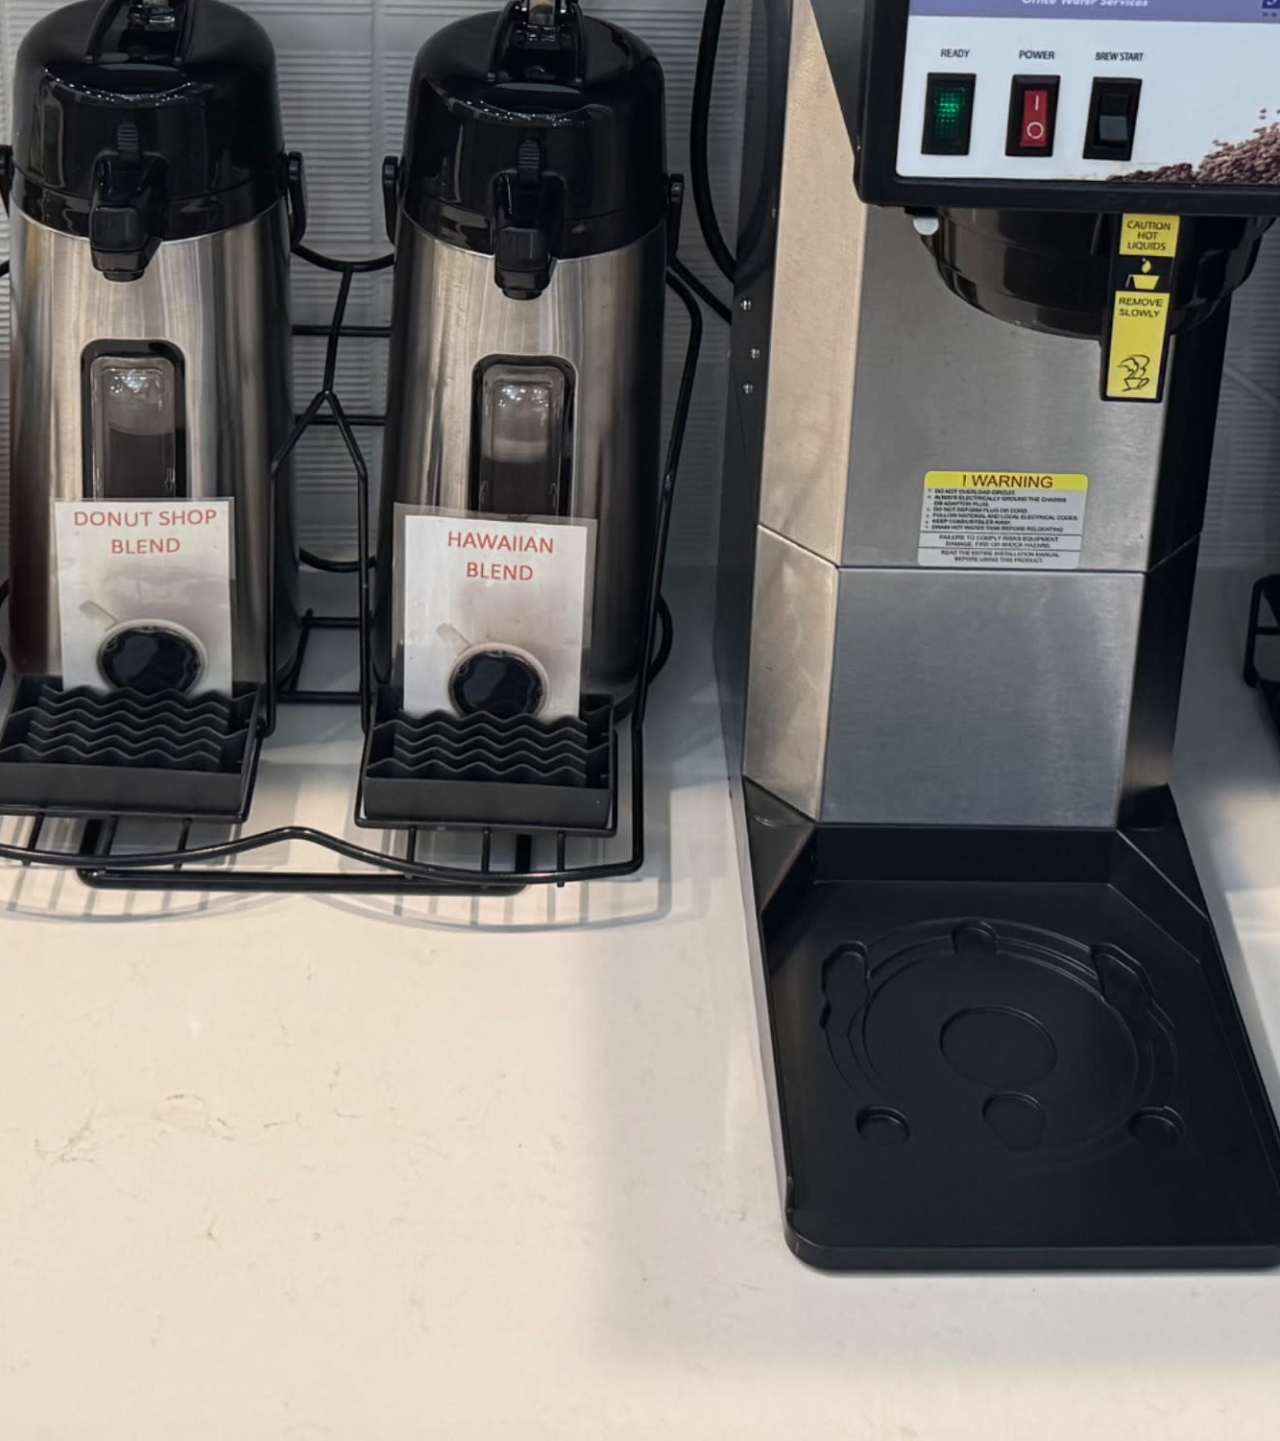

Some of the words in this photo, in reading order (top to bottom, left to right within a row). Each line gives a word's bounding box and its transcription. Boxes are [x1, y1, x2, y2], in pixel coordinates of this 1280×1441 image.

[941, 48, 970, 58] READY
[1019, 50, 1055, 60] POWER
[1095, 51, 1118, 61] BREW
[1120, 52, 1144, 61] START
[1127, 220, 1171, 230] CAUTION
[1137, 231, 1159, 240] HOT
[1127, 242, 1166, 251] LIQUIDS
[1119, 297, 1163, 307] REMOVE
[1119, 309, 1160, 318] SLOWLY
[972, 475, 1054, 488] WARNING
[74, 510, 153, 527] DONUT
[159, 509, 217, 526] SHOP
[111, 537, 180, 554] BLEND
[448, 530, 554, 554] HAWAIIAN
[467, 561, 533, 581] BLEND
